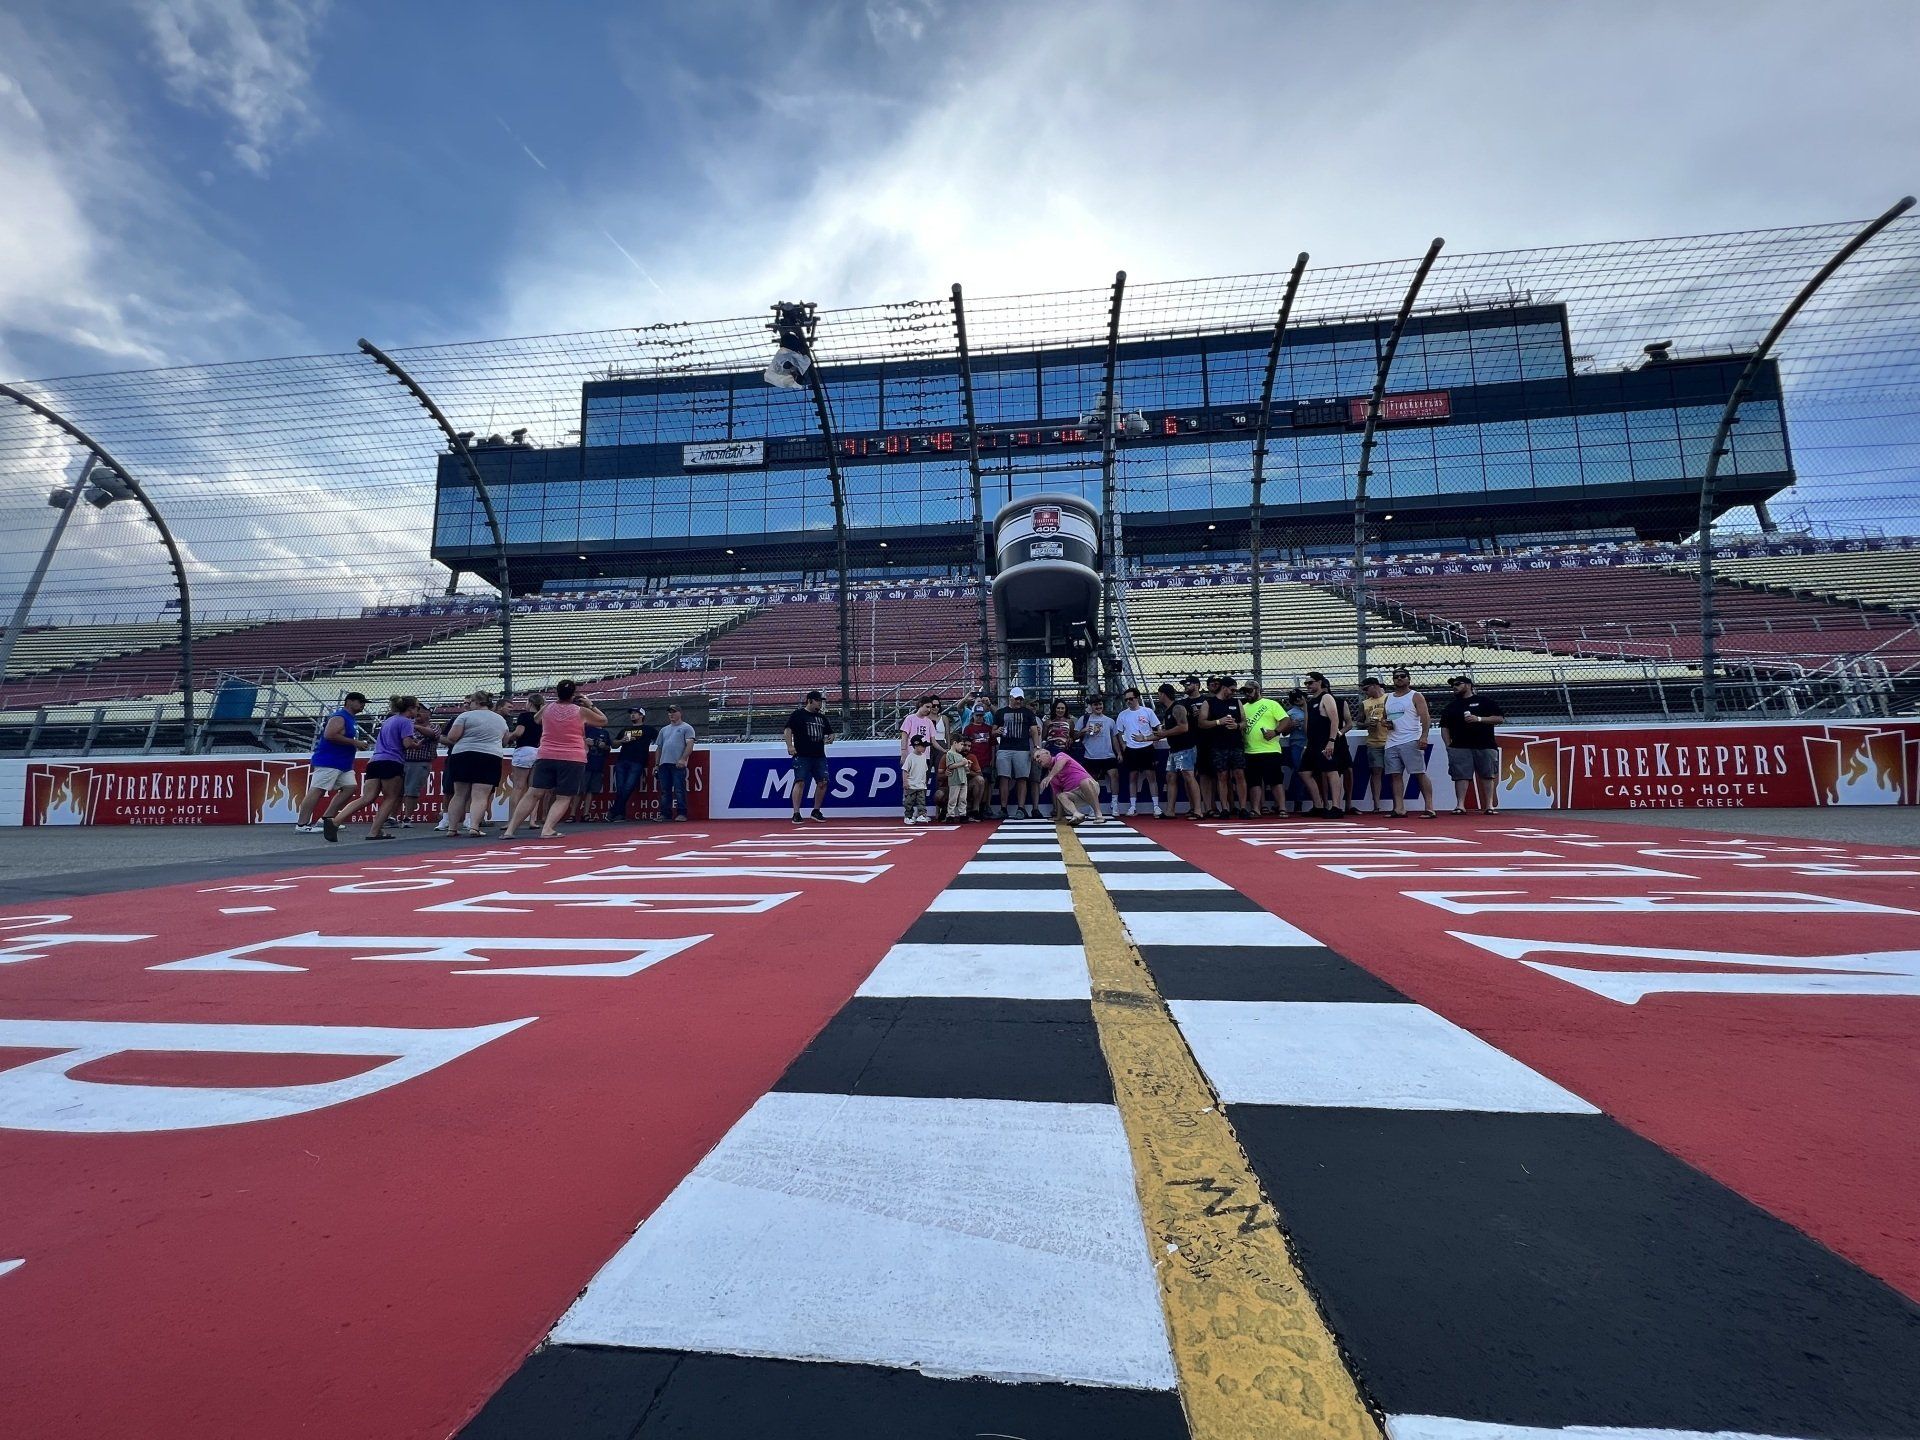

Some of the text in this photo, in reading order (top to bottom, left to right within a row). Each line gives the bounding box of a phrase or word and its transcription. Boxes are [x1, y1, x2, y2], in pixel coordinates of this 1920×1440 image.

[879, 441, 885, 449] 2
[700, 448, 743, 460] MICHIGAN
[1582, 743, 1787, 778] FIREKEEPERS
[105, 772, 235, 801] FIREKEEPERS
[1605, 783, 1768, 796] CASINO HOTEL
[1630, 798, 1745, 808] BATTLE CREEK
[116, 805, 219, 815] CASINO HOTEL
[130, 816, 203, 825] BATTLE CREEK
